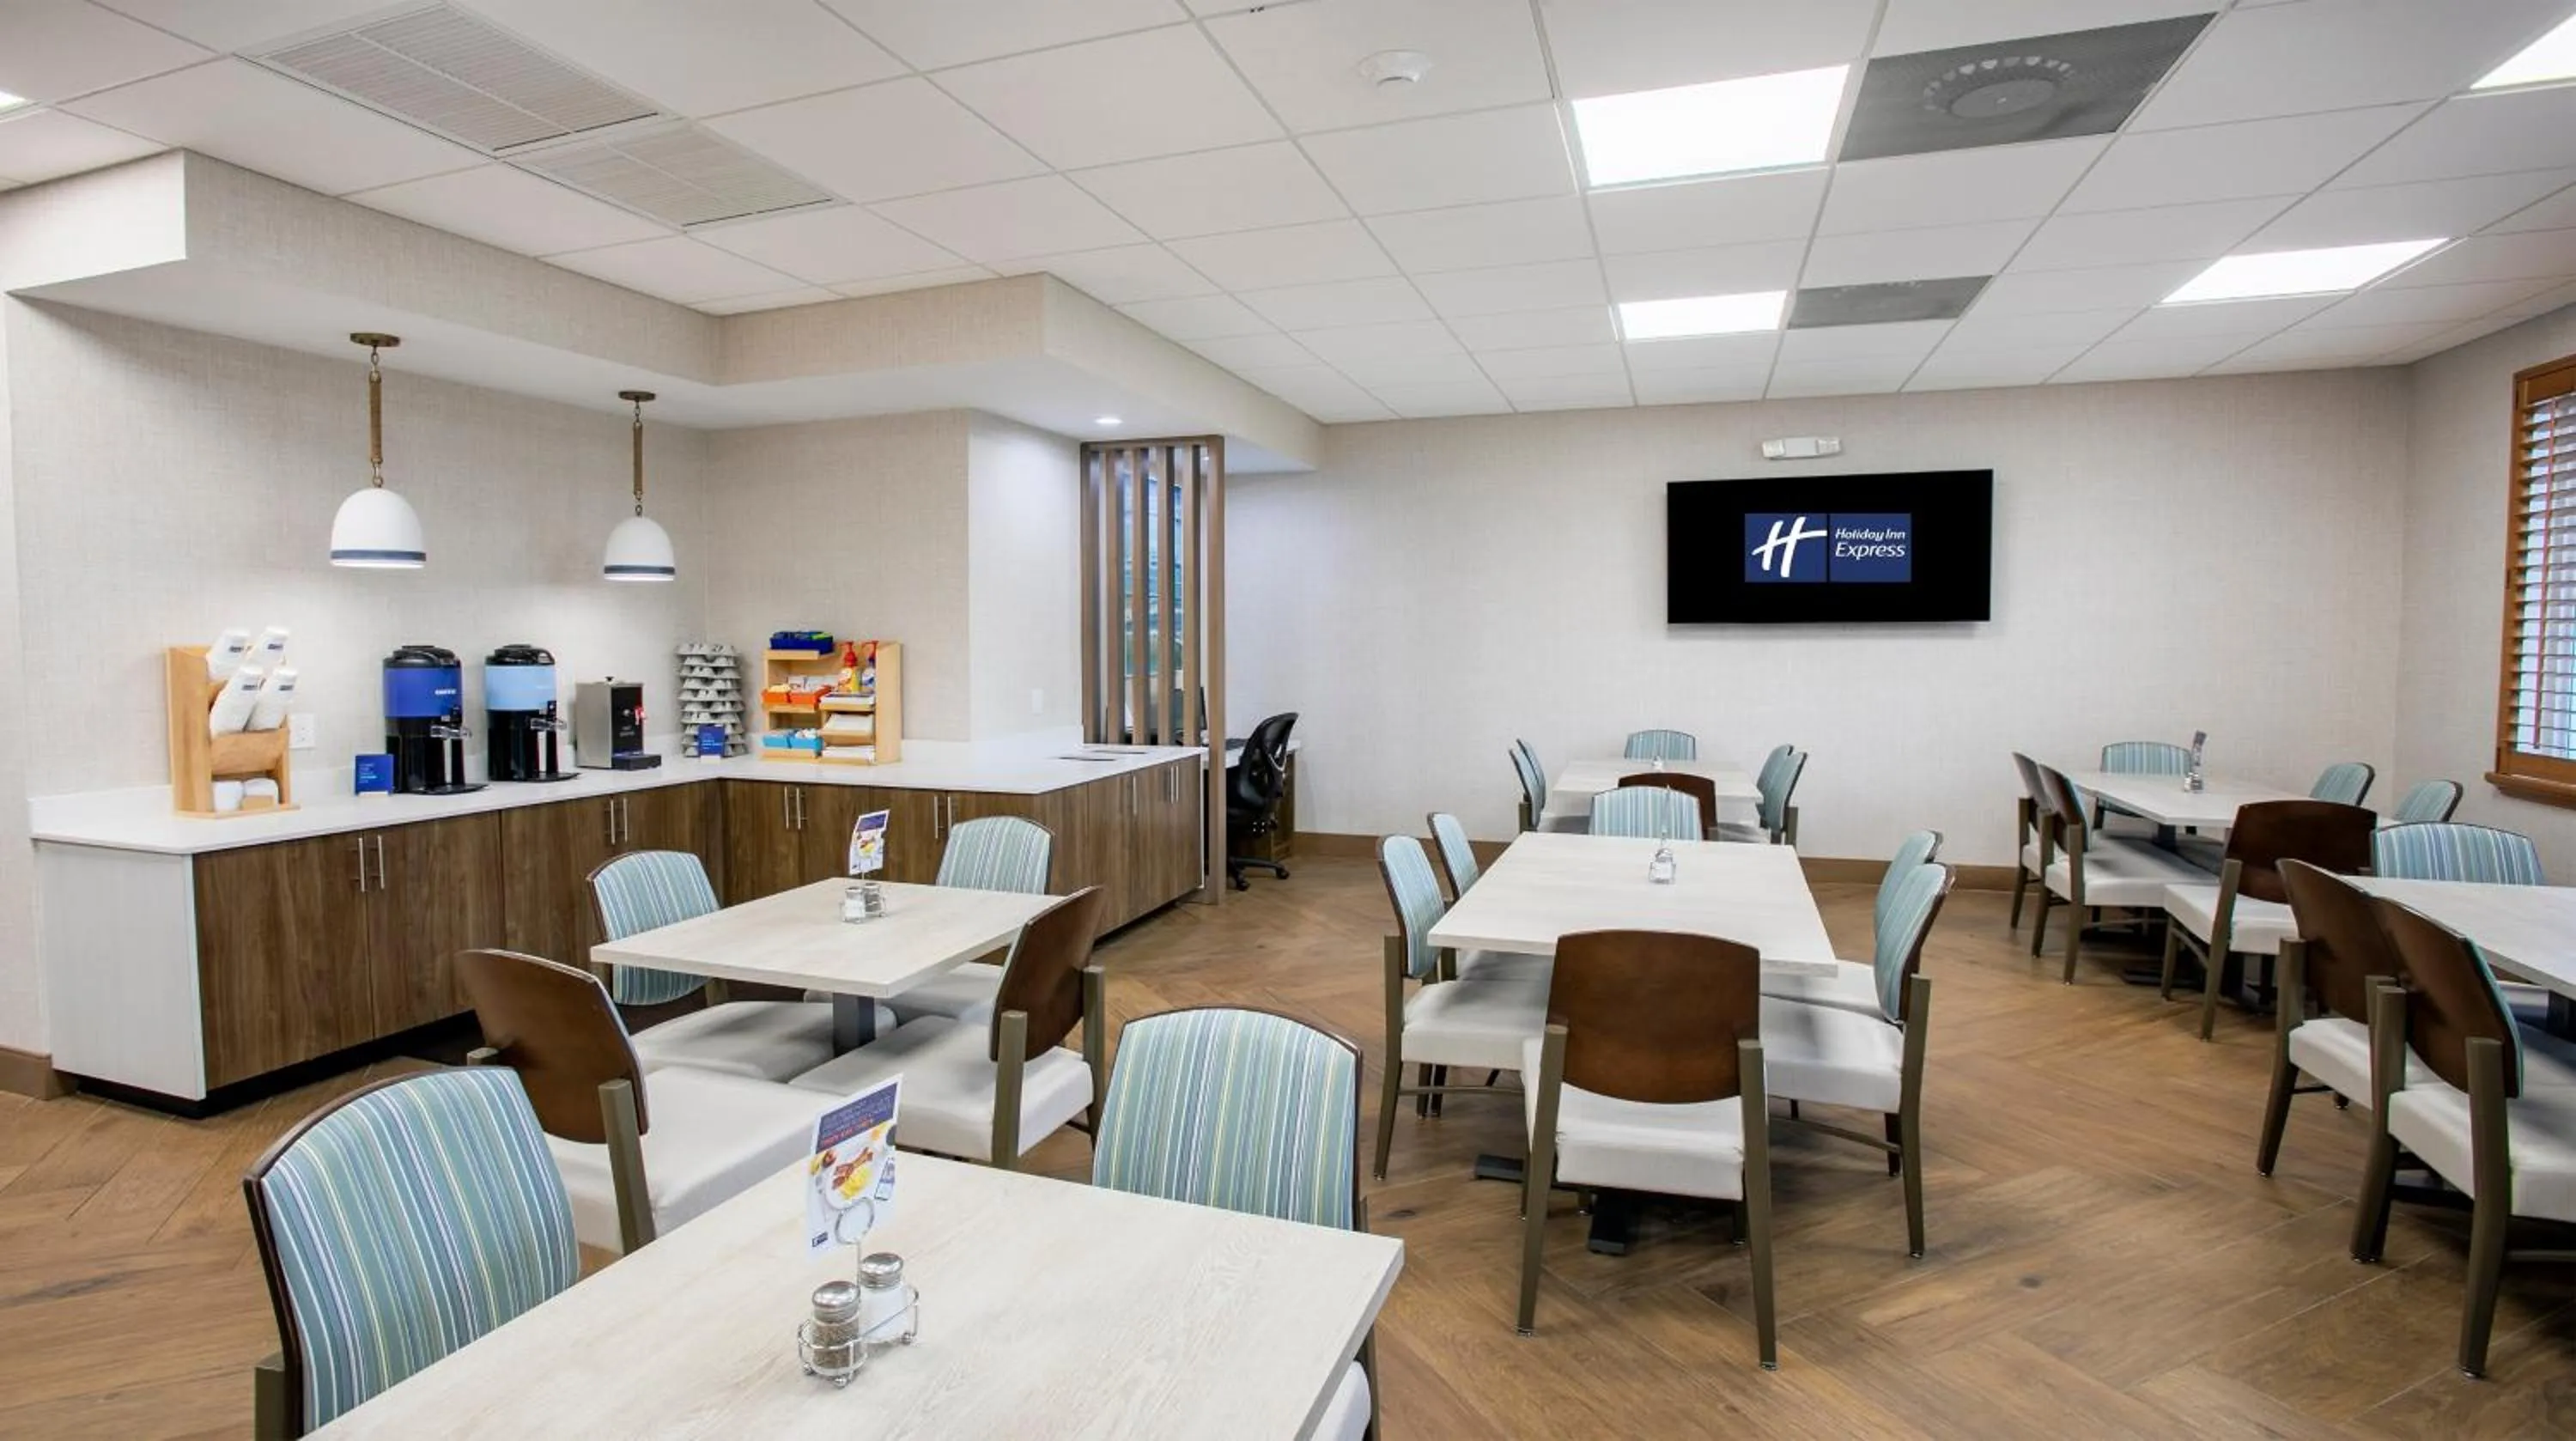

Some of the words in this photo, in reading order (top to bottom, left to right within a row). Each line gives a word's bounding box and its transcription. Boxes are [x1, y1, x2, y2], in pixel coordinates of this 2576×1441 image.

[1835, 528, 1884, 541] Holiday
[1885, 528, 1906, 540] Inn
[1835, 542, 1906, 561] Express
